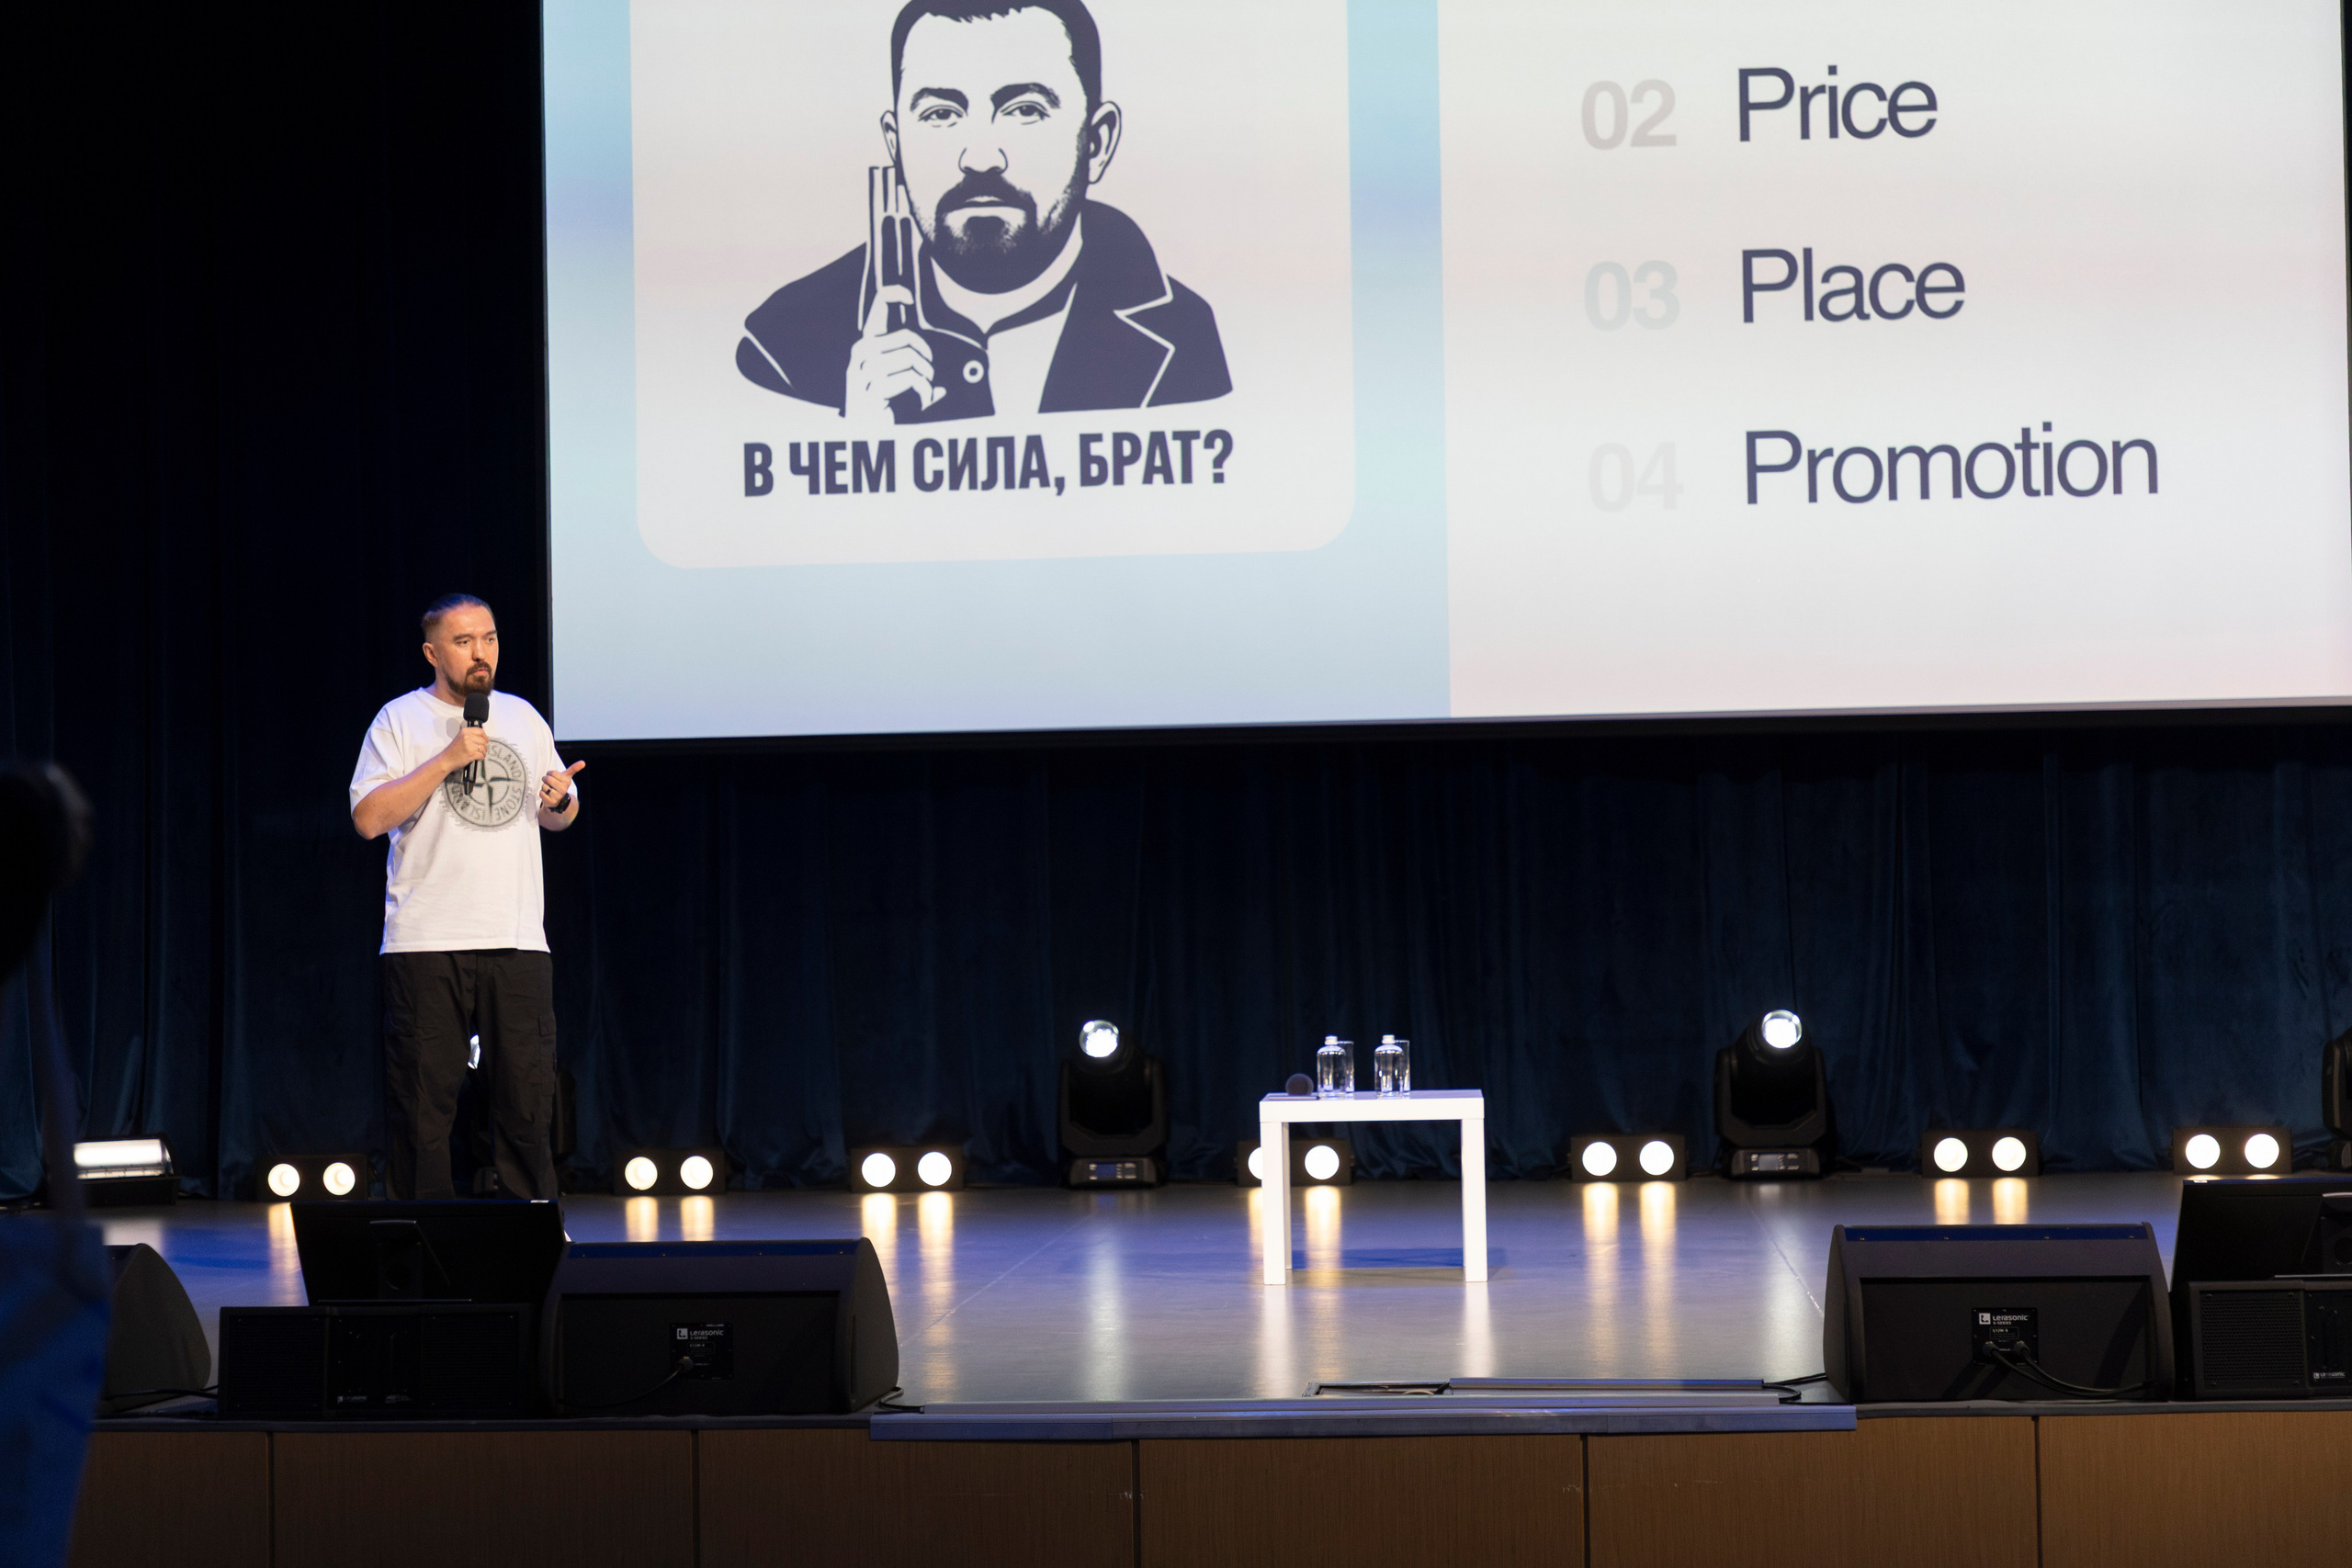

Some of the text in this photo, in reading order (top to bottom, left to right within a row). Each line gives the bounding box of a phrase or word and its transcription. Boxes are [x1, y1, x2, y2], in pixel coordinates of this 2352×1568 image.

[1580, 65, 1938, 151] 02 Price
[1583, 247, 1965, 331] 03 Place
[743, 429, 1234, 497] В ЧЕМ СИЛА, БРАТ?
[1588, 421, 2158, 513] 04 Promotion
[494, 784, 522, 821] STONE
